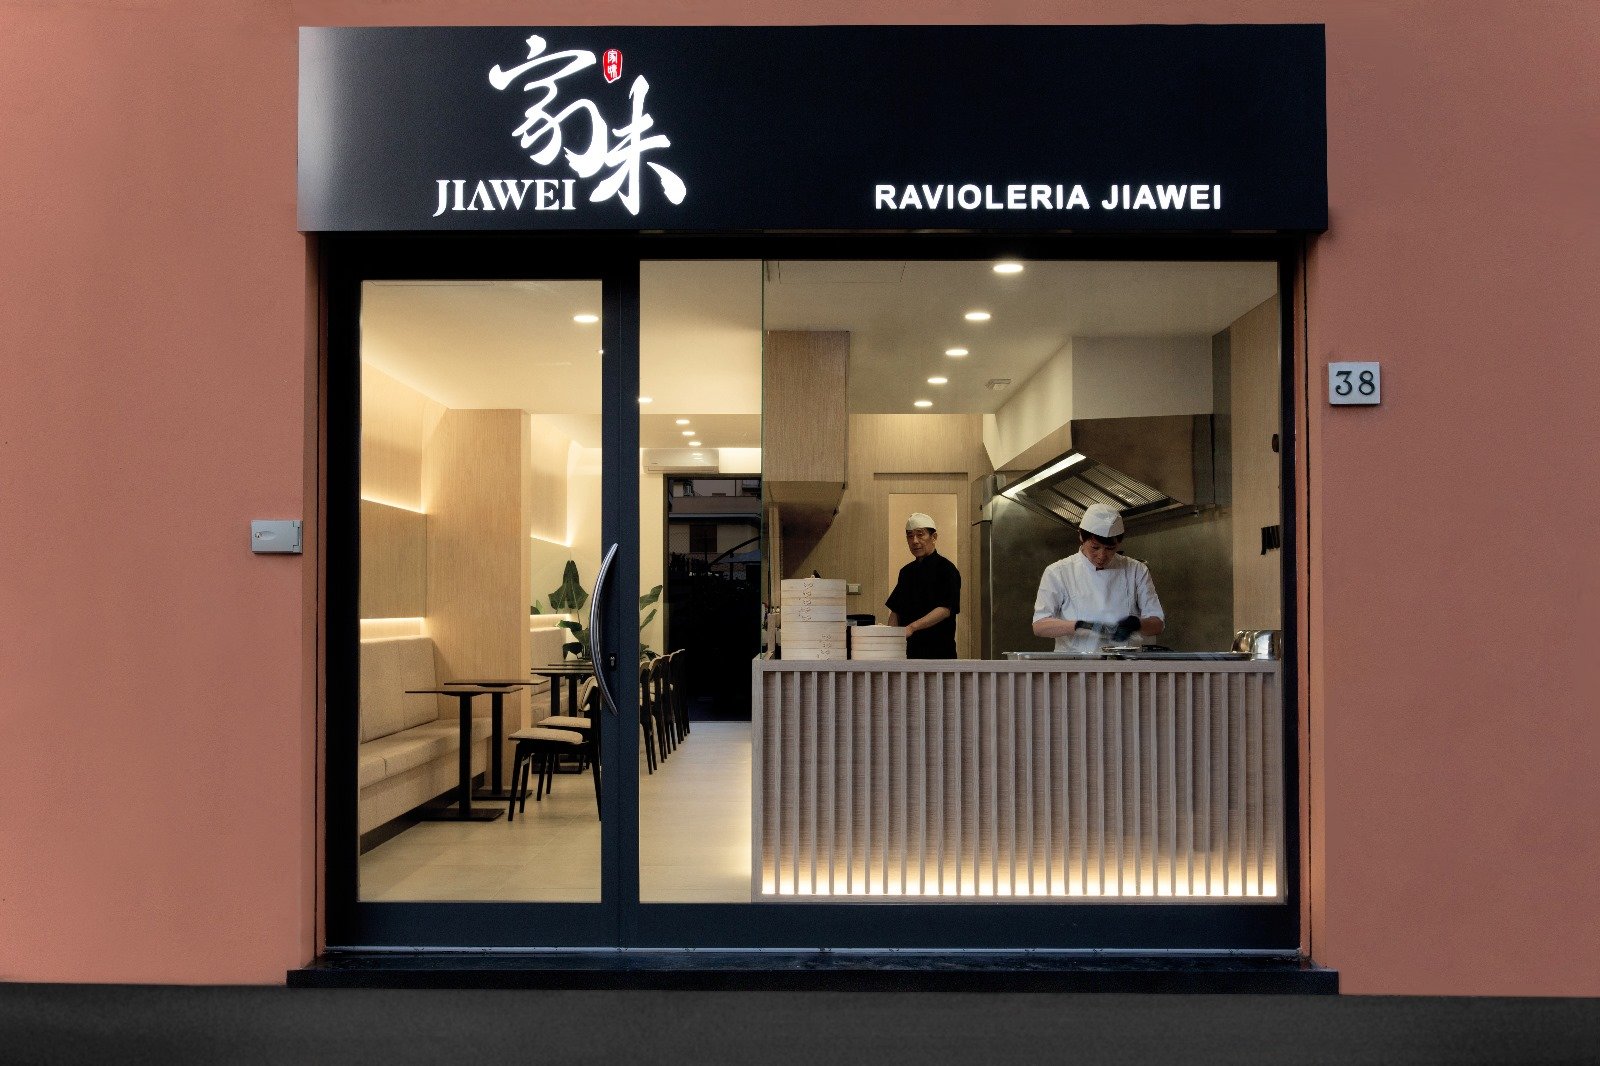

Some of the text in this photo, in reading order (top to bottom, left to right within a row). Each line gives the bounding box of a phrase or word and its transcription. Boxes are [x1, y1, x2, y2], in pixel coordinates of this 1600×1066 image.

[489, 35, 686, 215] 家味
[433, 179, 577, 217] JIAWEI
[875, 184, 1221, 210] RAVIOLERIA JIAWEI
[1335, 370, 1375, 396] 38
